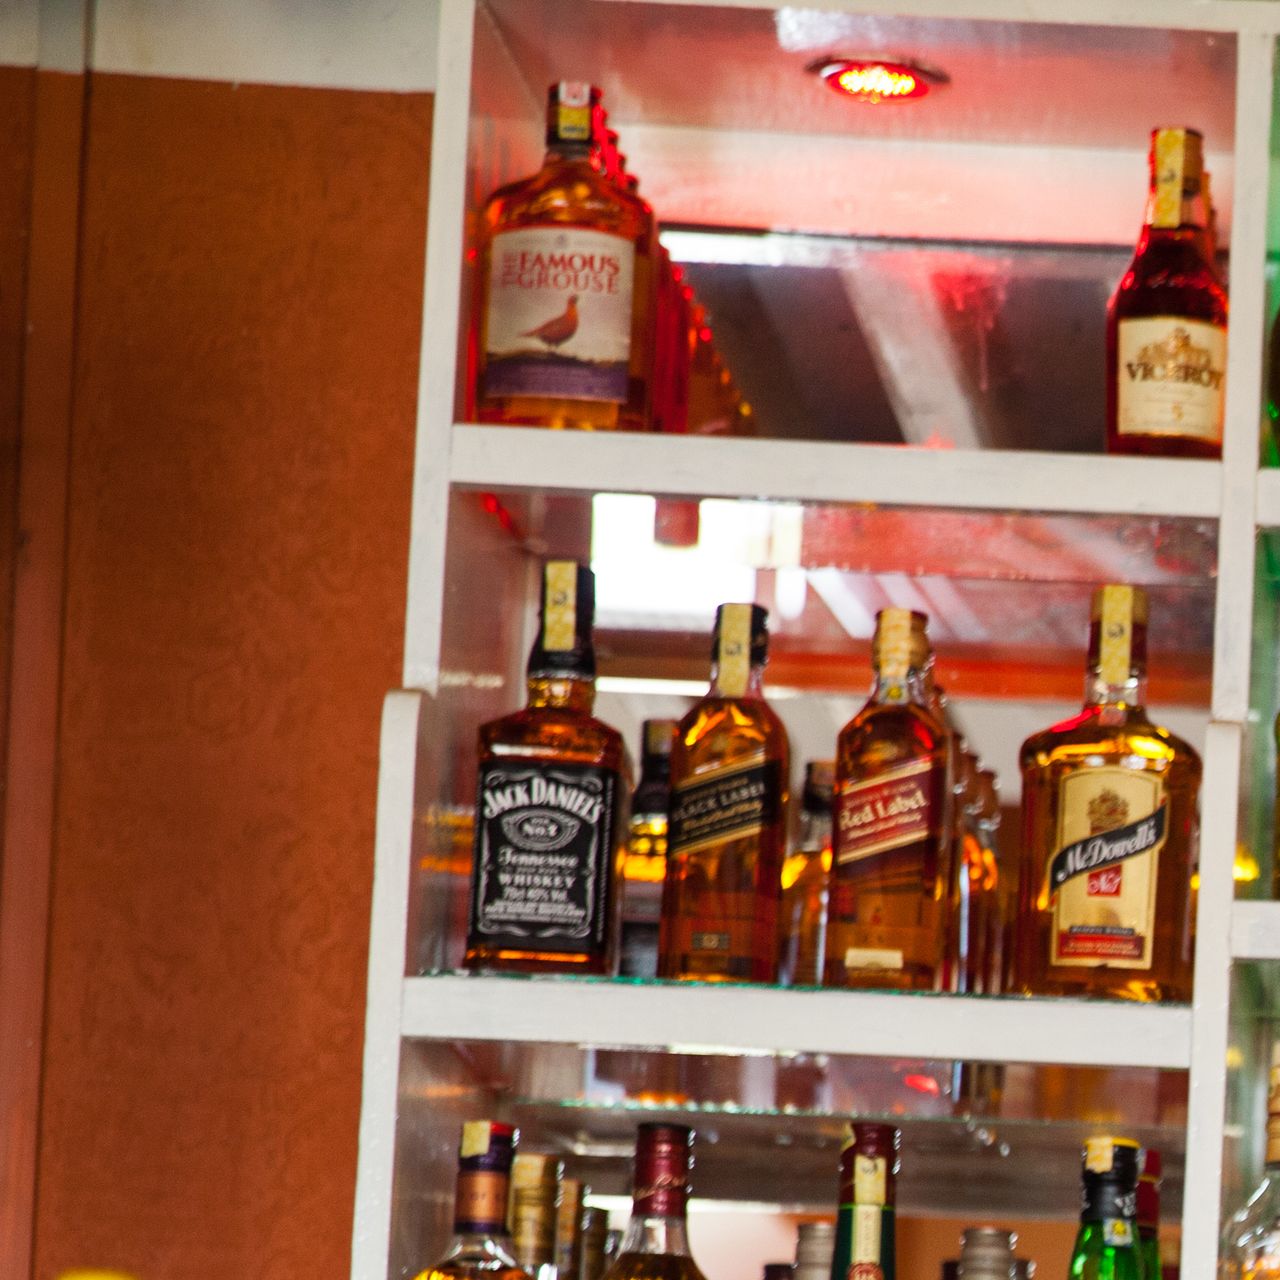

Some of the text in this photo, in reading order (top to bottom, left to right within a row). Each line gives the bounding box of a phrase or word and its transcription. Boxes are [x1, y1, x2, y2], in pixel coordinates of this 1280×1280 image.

[519, 252, 621, 276] FAMOUS
[516, 271, 621, 295] GROUSE
[483, 782, 531, 820] JACK
